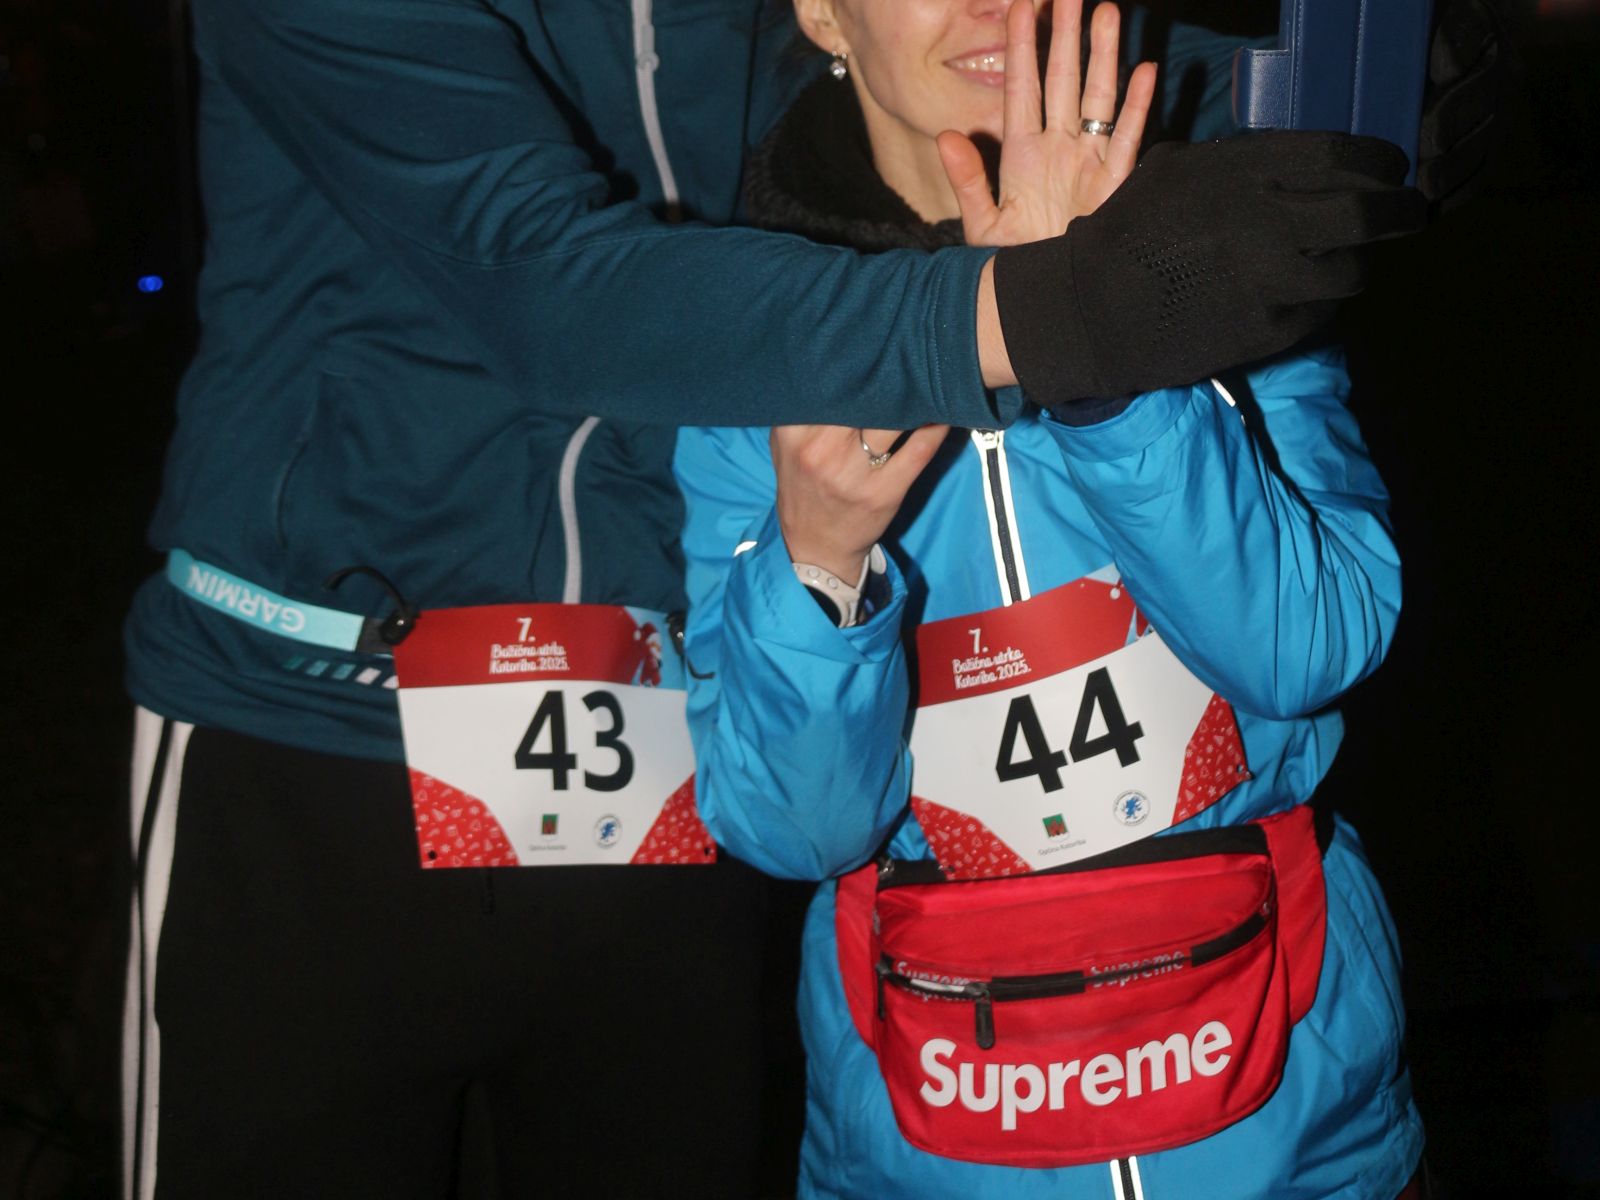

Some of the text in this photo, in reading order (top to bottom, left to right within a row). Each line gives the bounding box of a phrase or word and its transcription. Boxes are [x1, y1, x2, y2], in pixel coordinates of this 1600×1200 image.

[187, 564, 306, 633] GARMIN
[516, 616, 536, 642] 7.
[968, 627, 989, 655] 7.
[996, 659, 1033, 681] 2025.
[514, 689, 635, 792] 43
[995, 666, 1145, 794] 44
[919, 1020, 1233, 1132] Supreme
